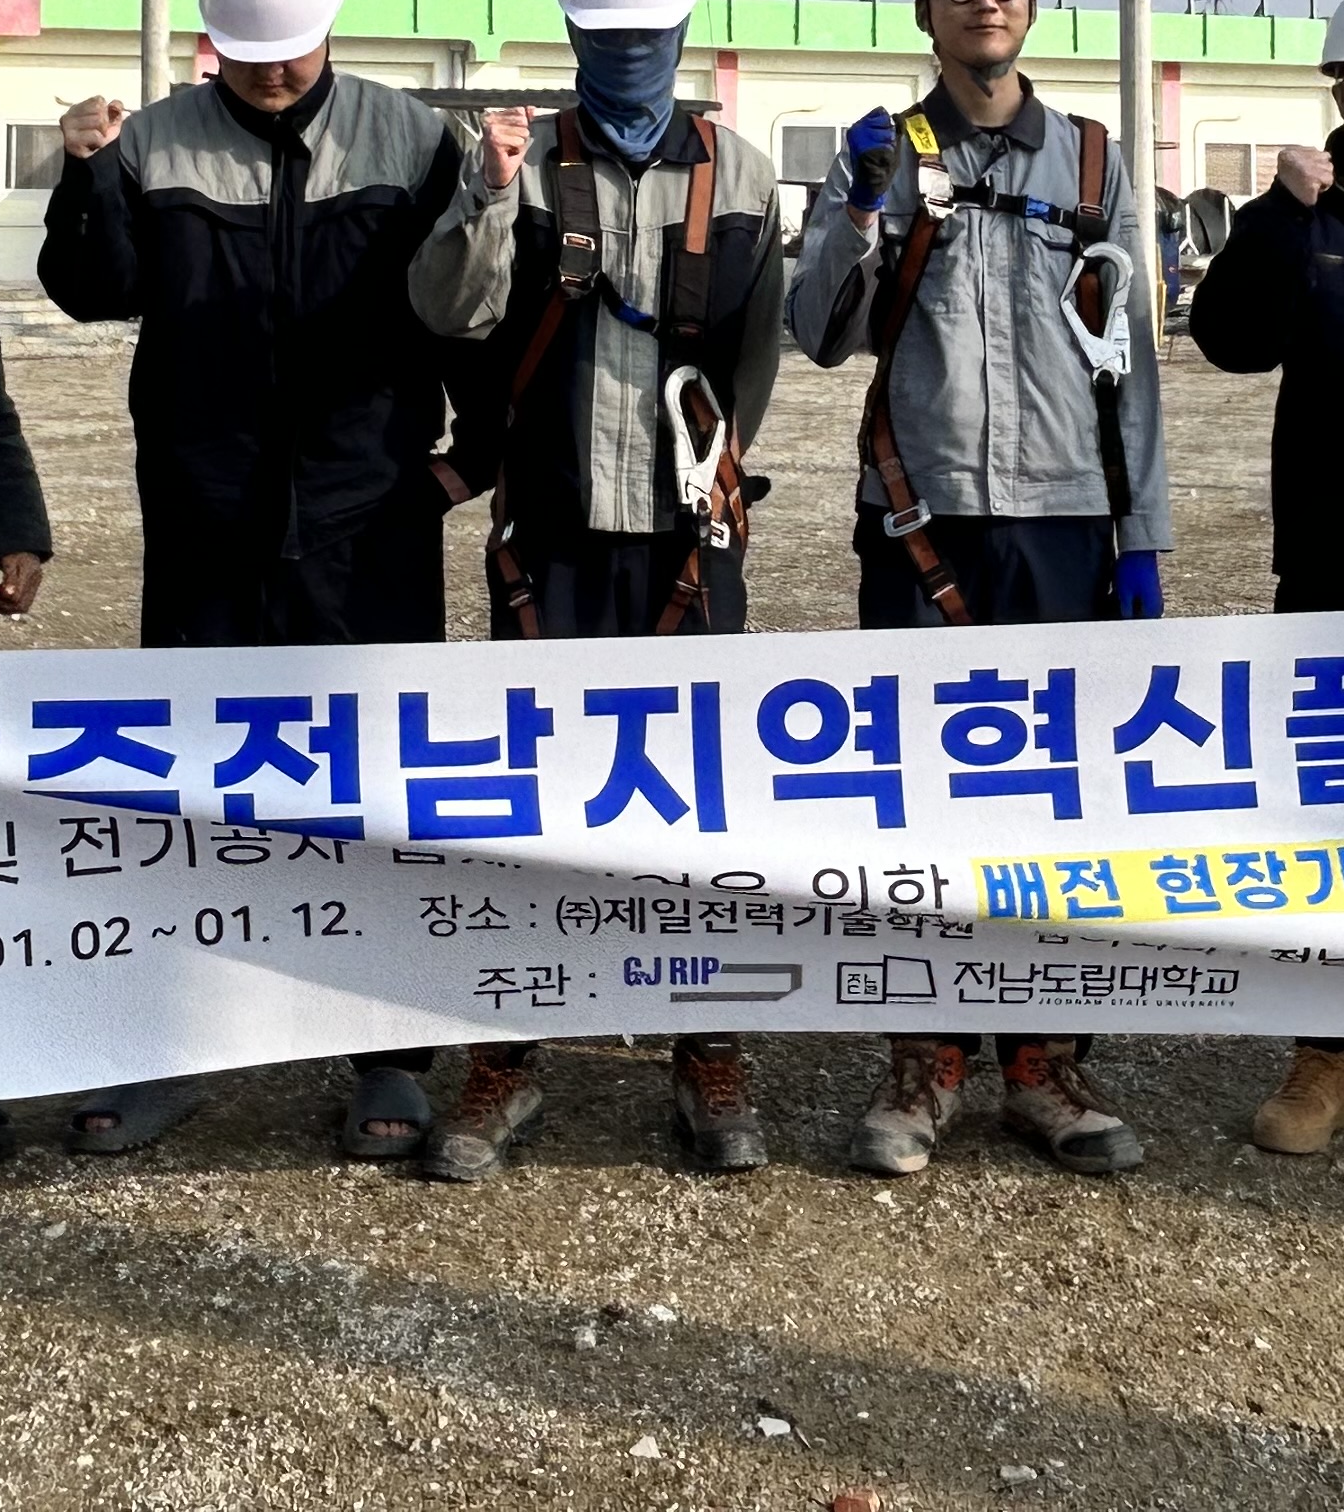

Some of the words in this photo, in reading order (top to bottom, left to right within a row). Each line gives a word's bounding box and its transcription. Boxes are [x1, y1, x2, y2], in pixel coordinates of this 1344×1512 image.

[982, 858, 1123, 921] 배전
[71, 916, 133, 961] 02
[194, 905, 270, 947] 01.
[291, 899, 363, 938] 12.
[419, 894, 511, 935] 장소
[472, 963, 572, 1010] 주관
[953, 961, 1240, 1005] 전남도립대학교
